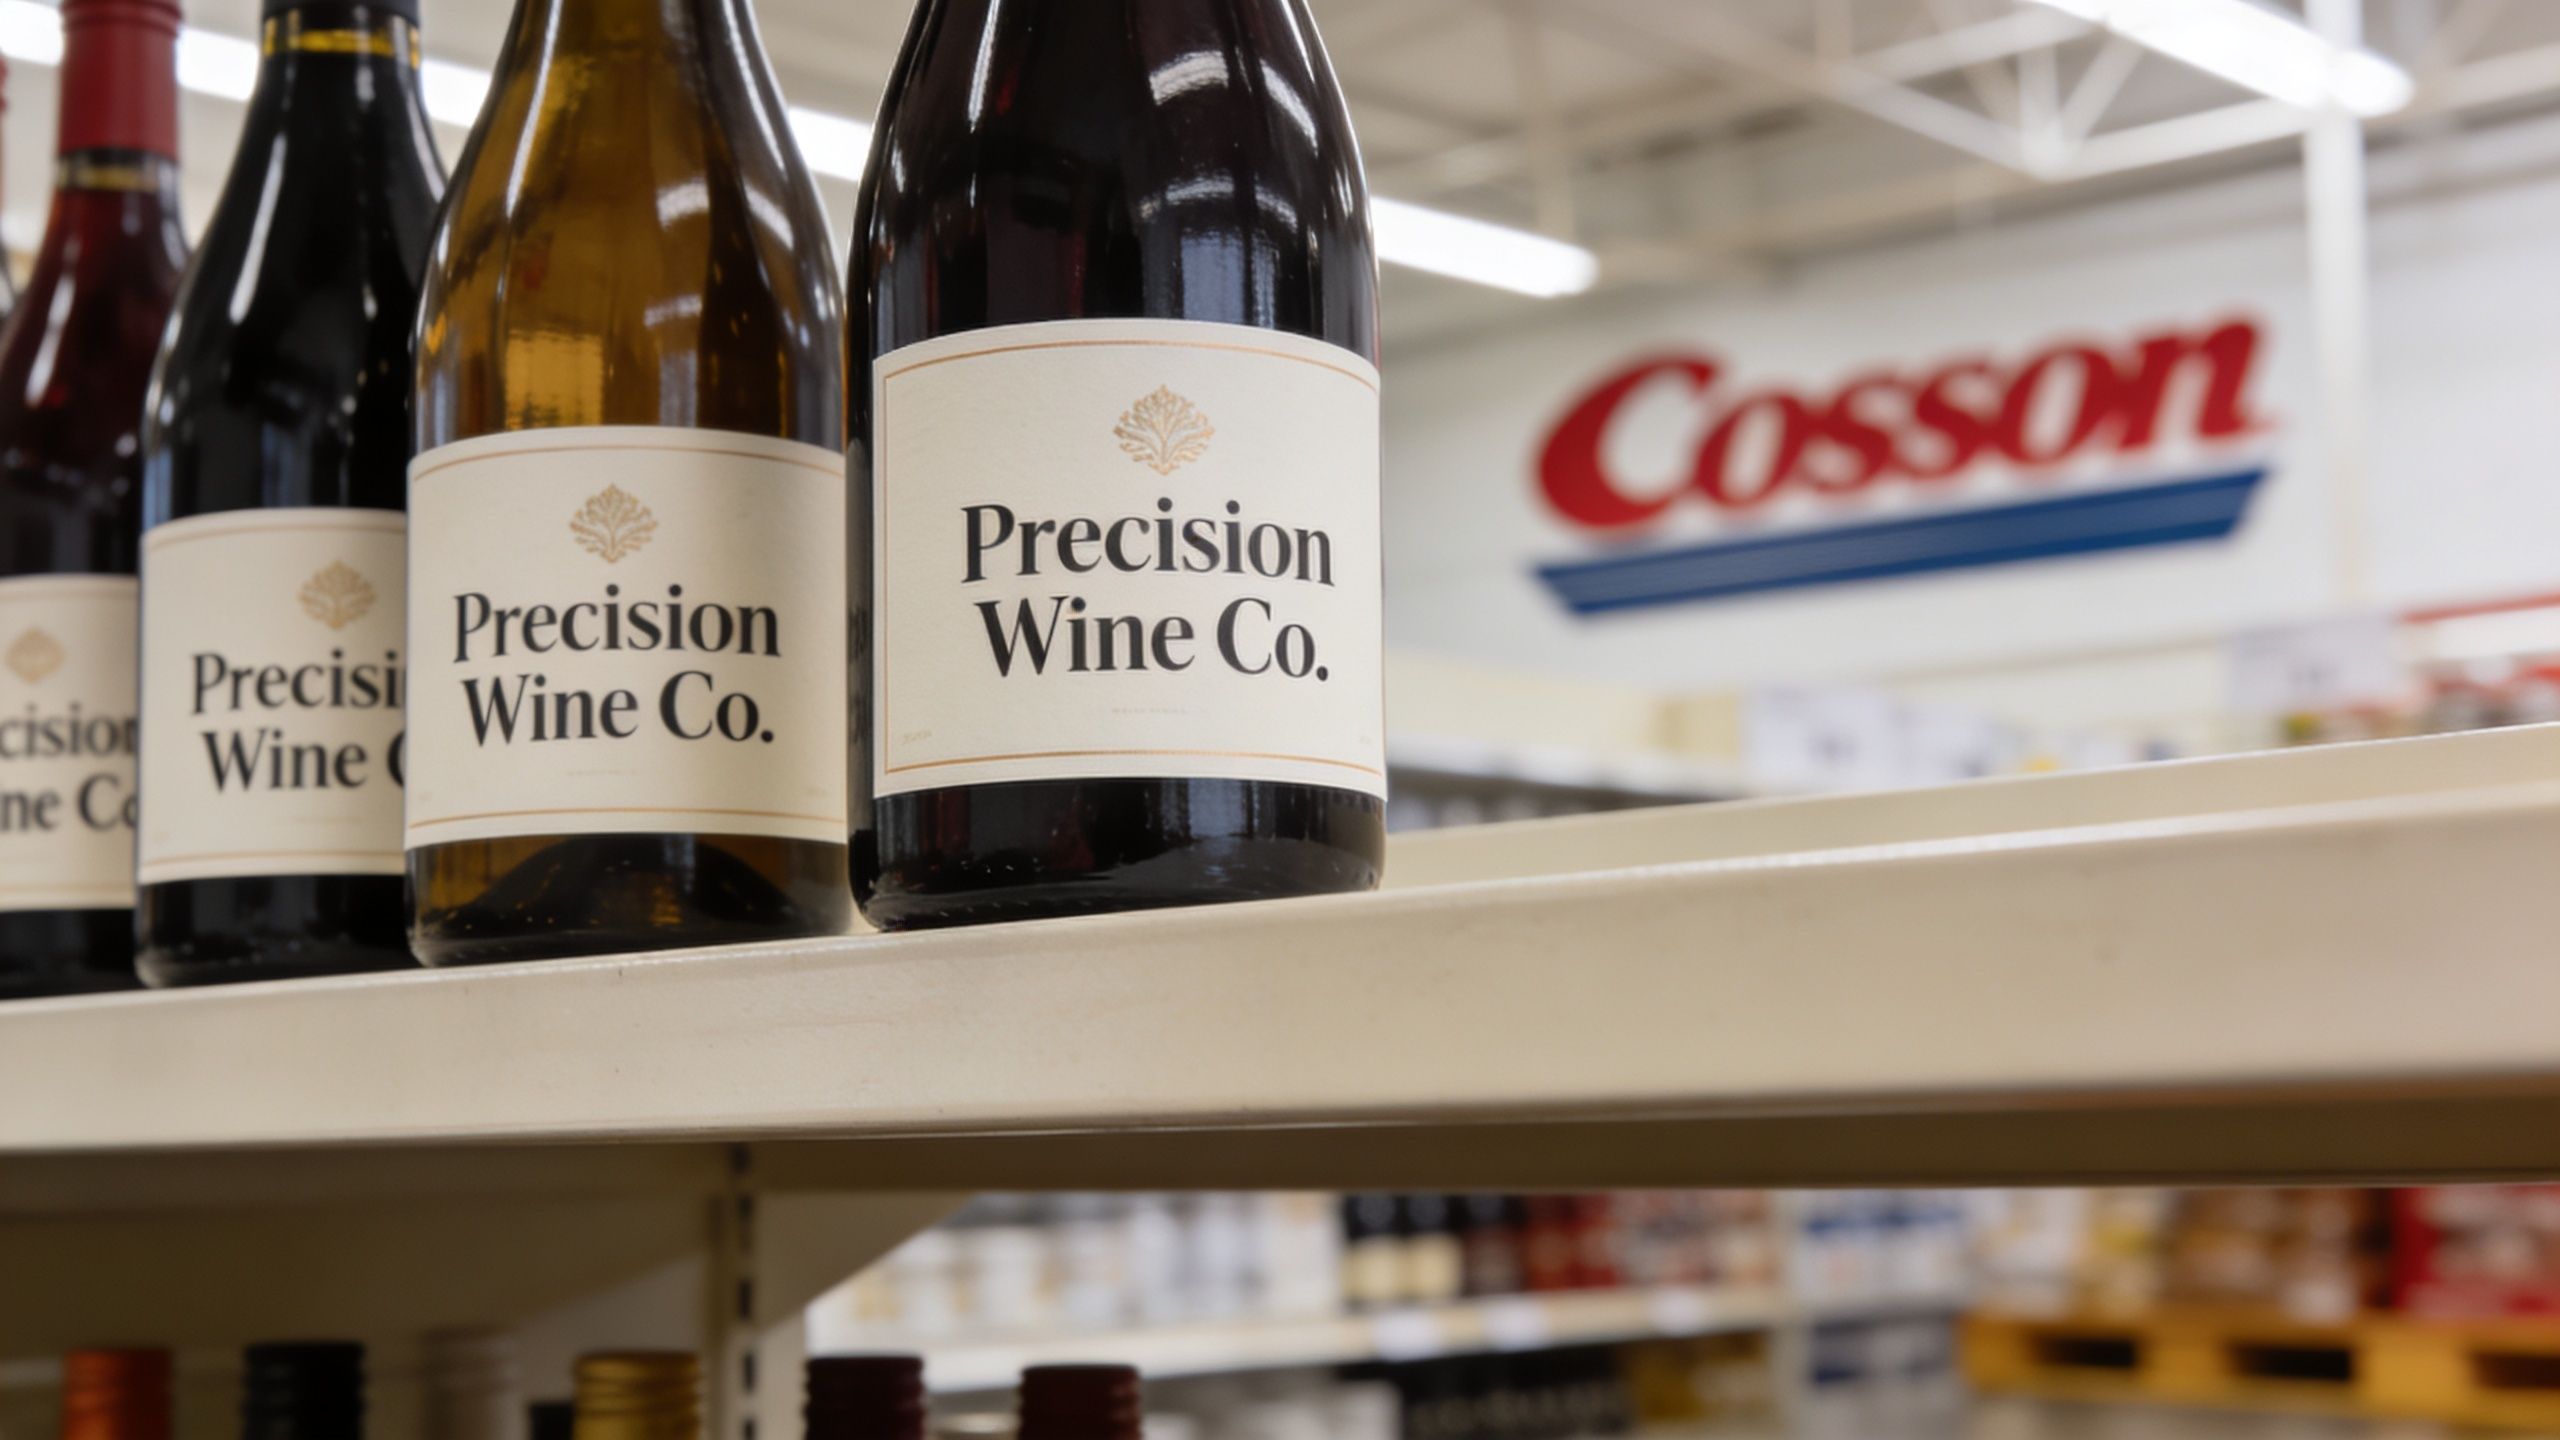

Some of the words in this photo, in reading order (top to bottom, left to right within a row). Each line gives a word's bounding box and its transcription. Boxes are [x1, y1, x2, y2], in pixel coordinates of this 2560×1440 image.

[1533, 315, 2268, 534] Cosson
[960, 496, 1335, 587] Precision
[453, 583, 781, 663] Precision
[974, 596, 1195, 677] Wine
[1216, 597, 1329, 682] Co.
[192, 649, 405, 715] Precisi
[461, 673, 639, 746] Wine
[658, 670, 775, 744] Co.
[202, 728, 367, 792] Wine
